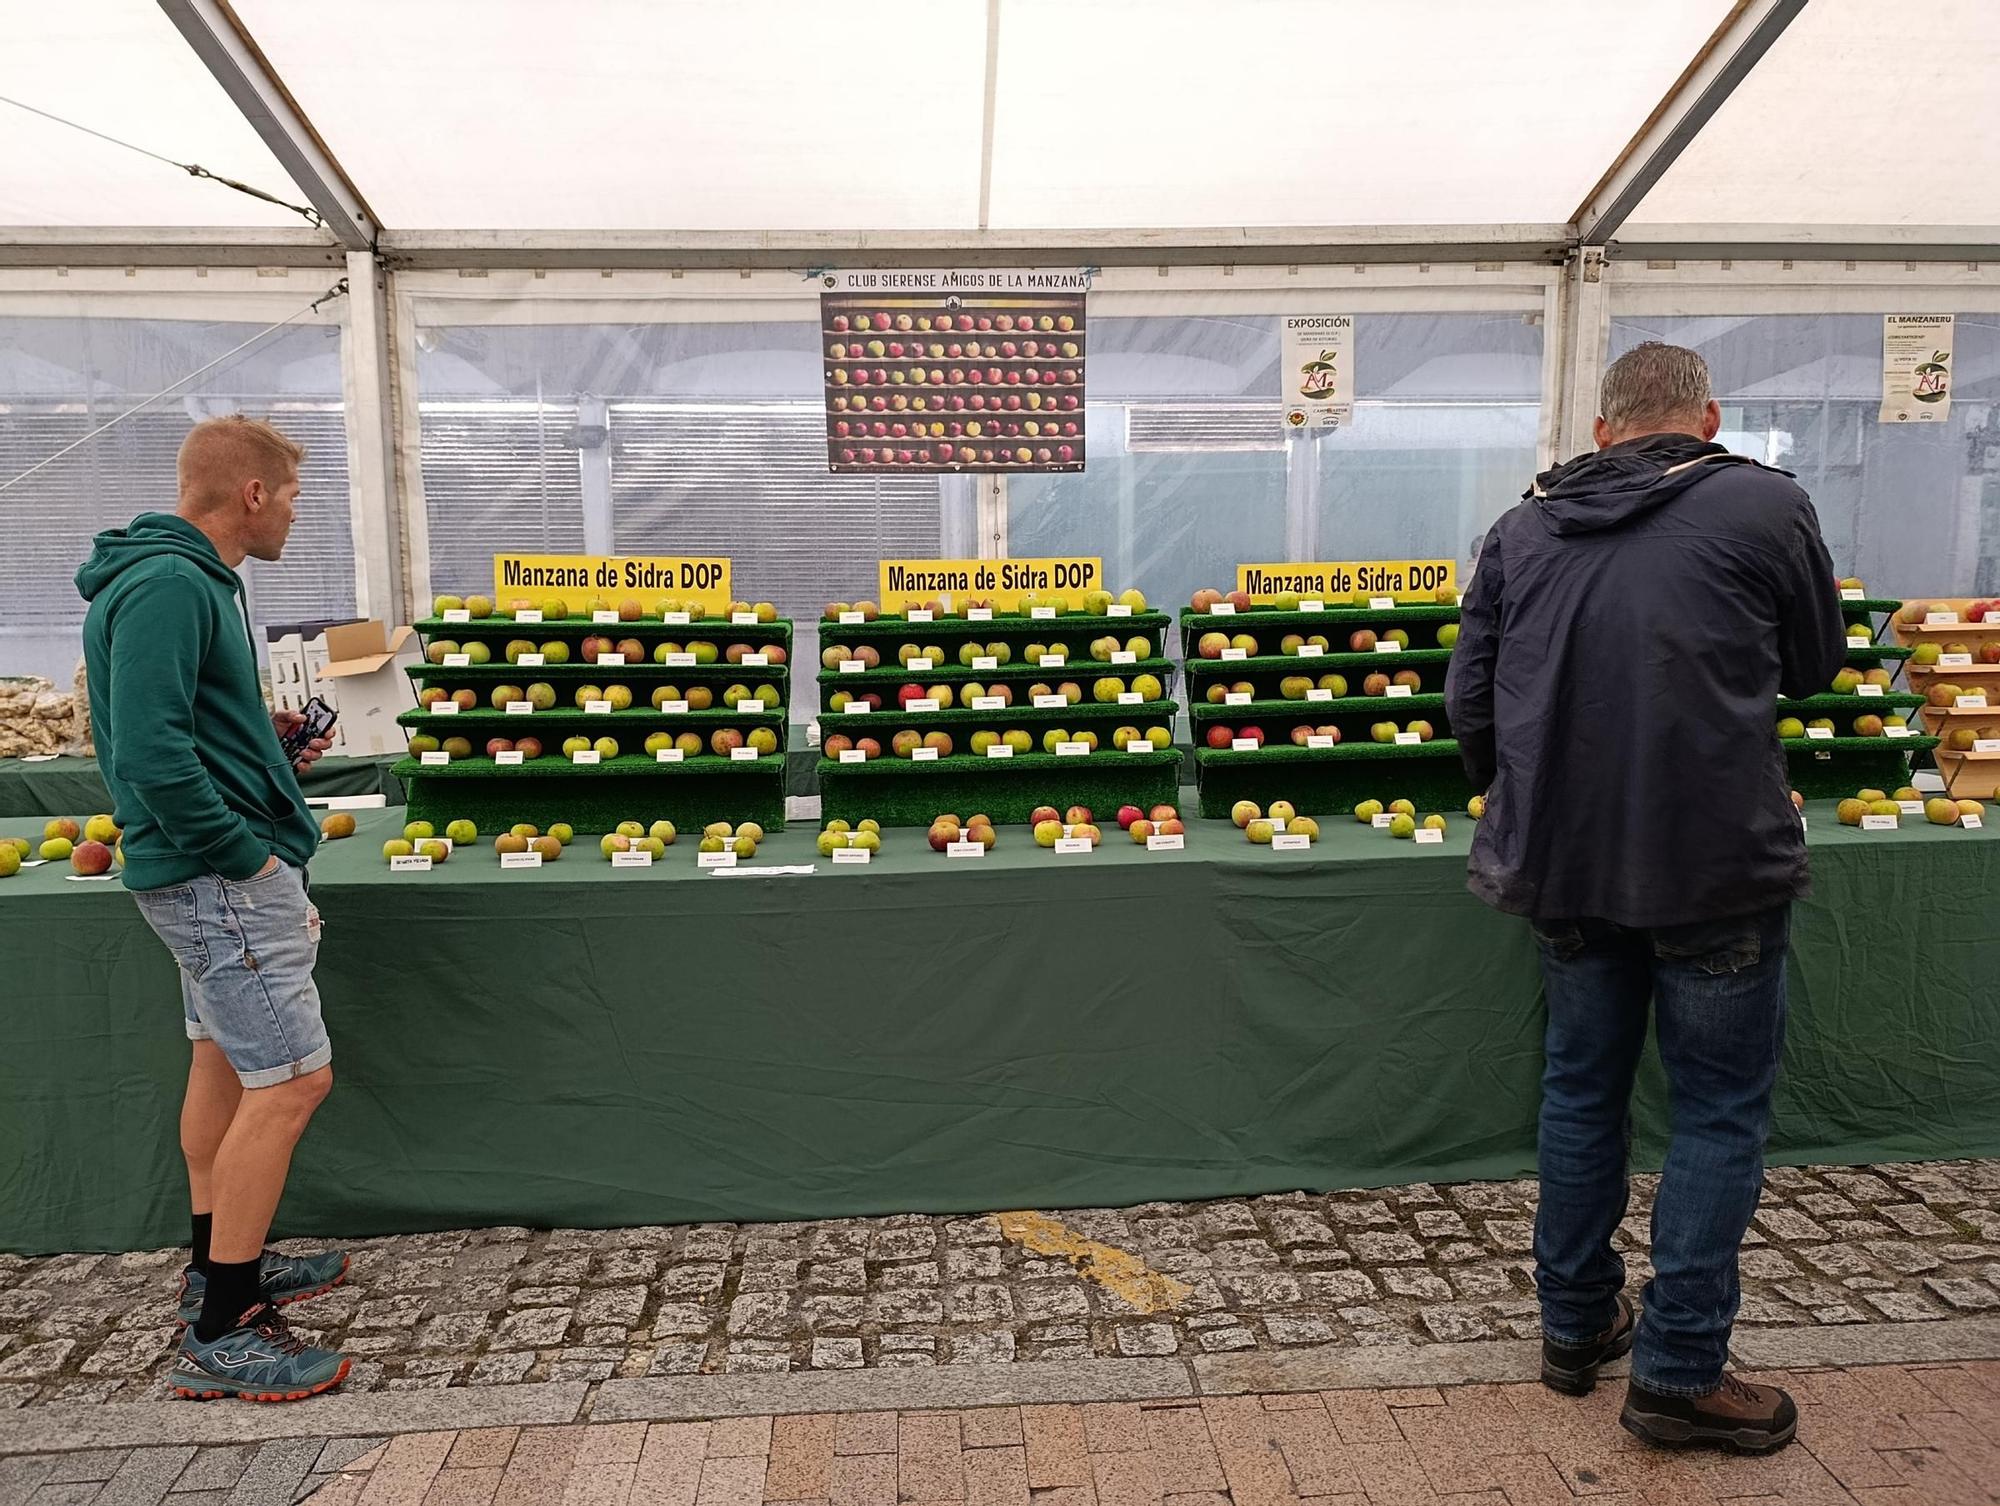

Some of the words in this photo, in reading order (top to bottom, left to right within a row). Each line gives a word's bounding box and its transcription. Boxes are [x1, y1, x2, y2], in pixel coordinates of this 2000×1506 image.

[848, 275, 877, 287] CLUB
[881, 275, 937, 287] SIERENSE
[942, 274, 984, 287] AMIGOS
[989, 274, 1003, 287] DE
[1008, 275, 1022, 287] LA
[1028, 275, 1086, 288] MANZANA
[1287, 316, 1350, 329] EXPOSICIÓN
[504, 560, 588, 587] Manzana
[596, 562, 618, 588] de
[625, 562, 673, 588] Sidra
[681, 563, 722, 589] DOP
[888, 566, 968, 591] Manzana
[975, 565, 995, 590] de
[1002, 564, 1047, 589] Sidra
[1055, 563, 1094, 588] DOP
[1246, 570, 1324, 595] Manzana
[1331, 568, 1351, 592] de
[1357, 567, 1402, 591] Sidra
[1409, 566, 1448, 591] DOP
